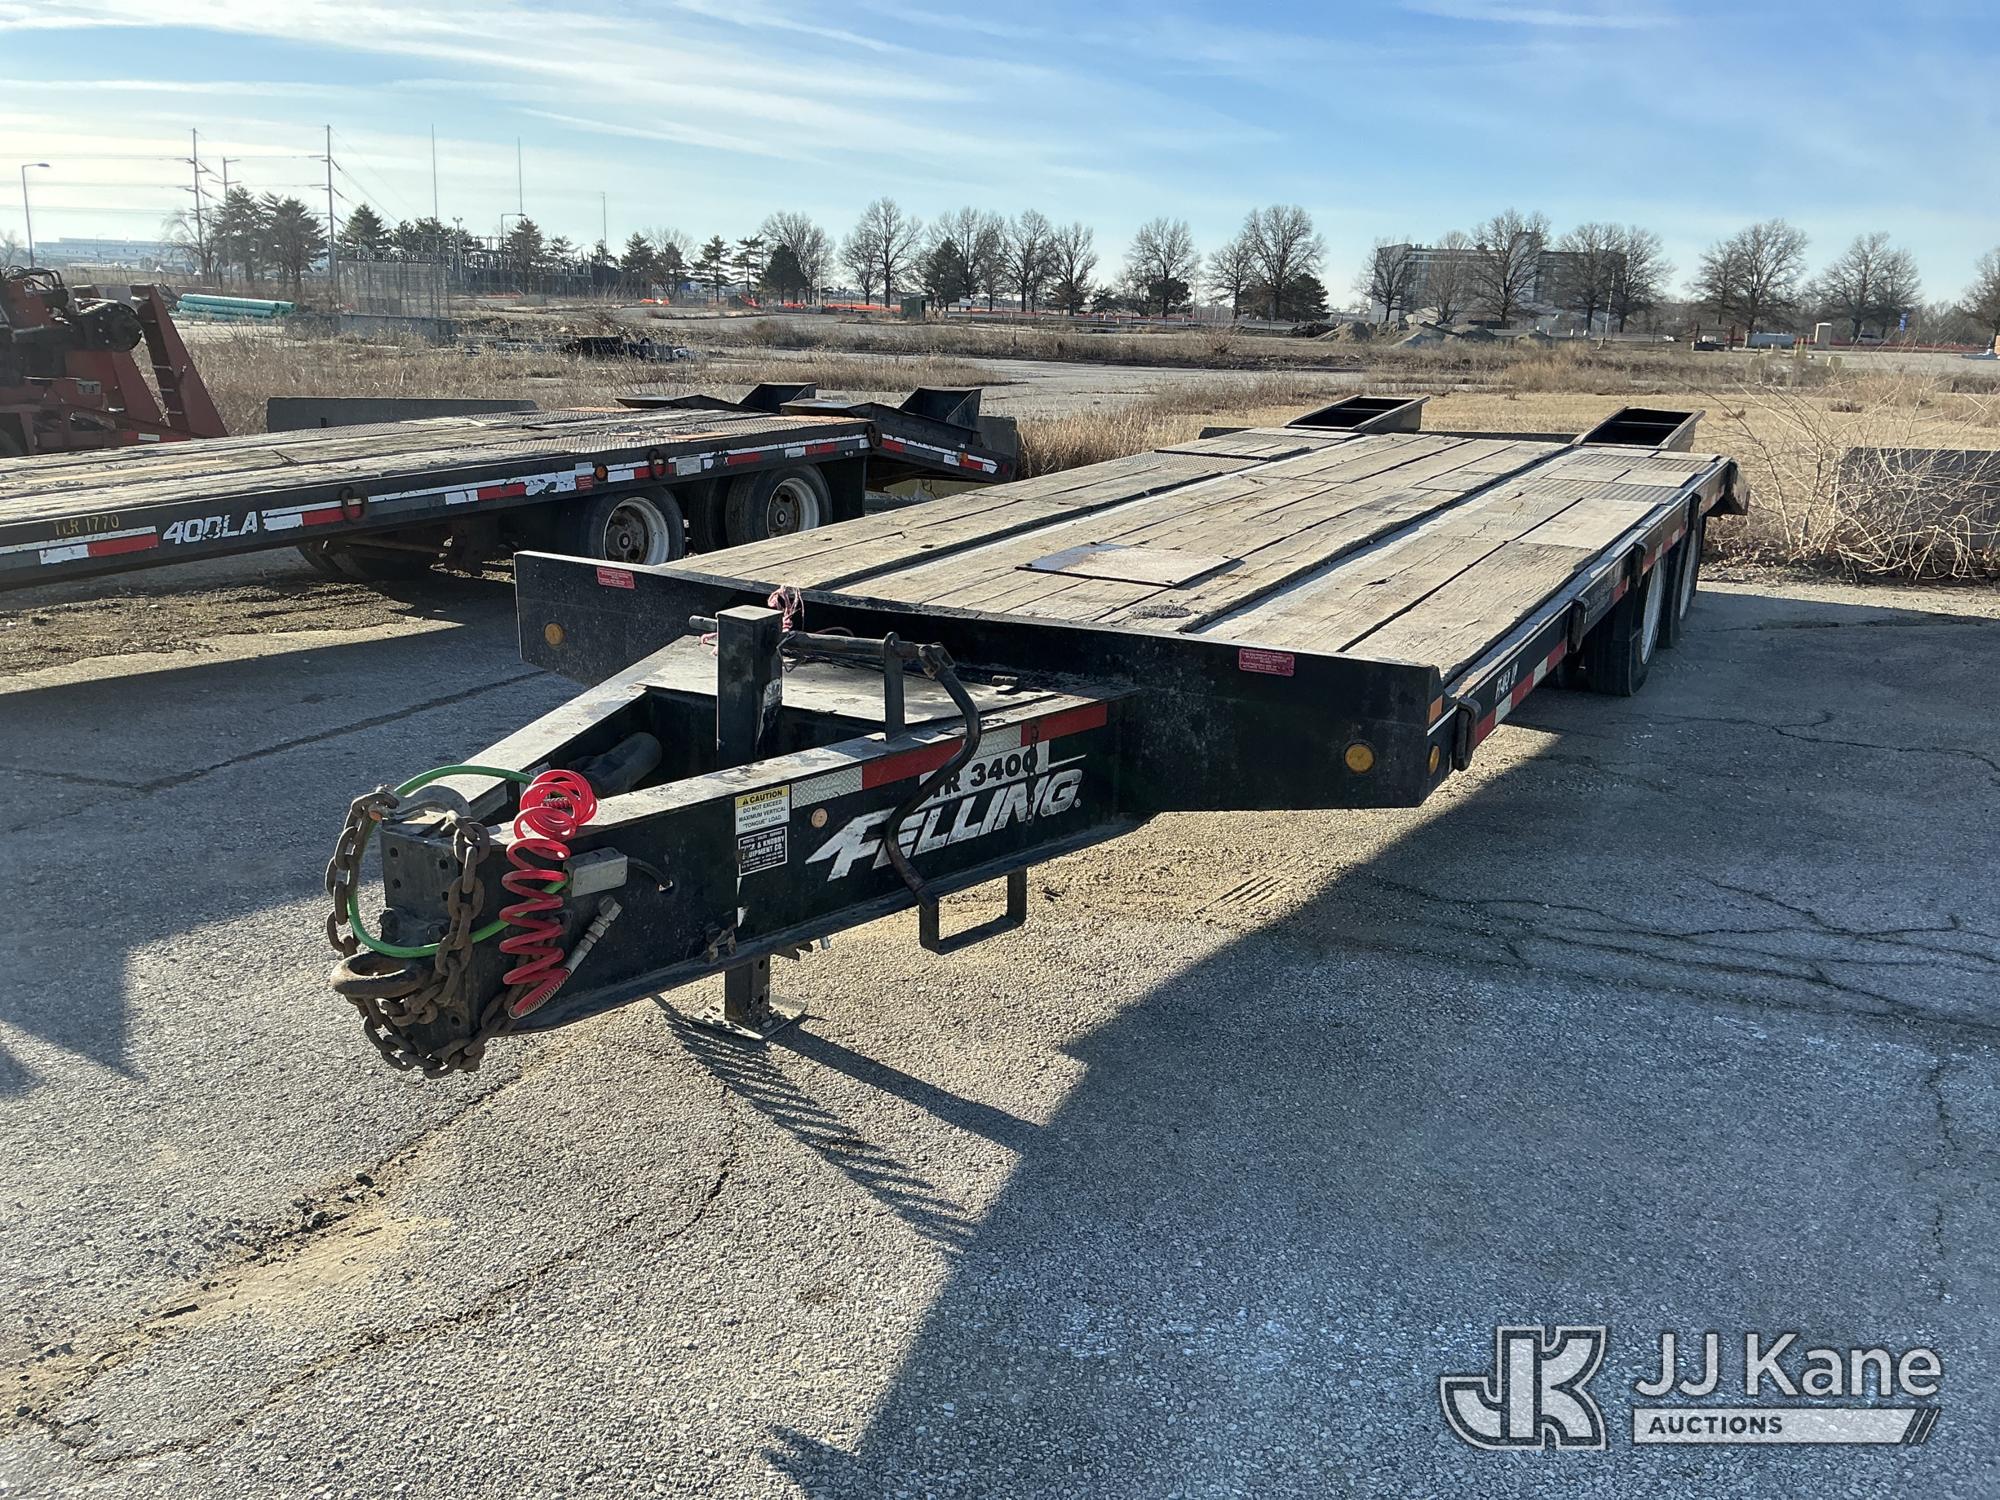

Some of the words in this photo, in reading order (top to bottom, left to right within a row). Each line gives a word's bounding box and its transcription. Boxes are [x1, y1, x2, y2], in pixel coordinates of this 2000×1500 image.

[86, 515, 119, 532] 1770
[970, 749, 1036, 787] 3400
[750, 789, 783, 803] CAUTION
[763, 800, 782, 809] EXCEED
[739, 813, 762, 823] MAXIMUM
[764, 807, 786, 816] VERTICAL
